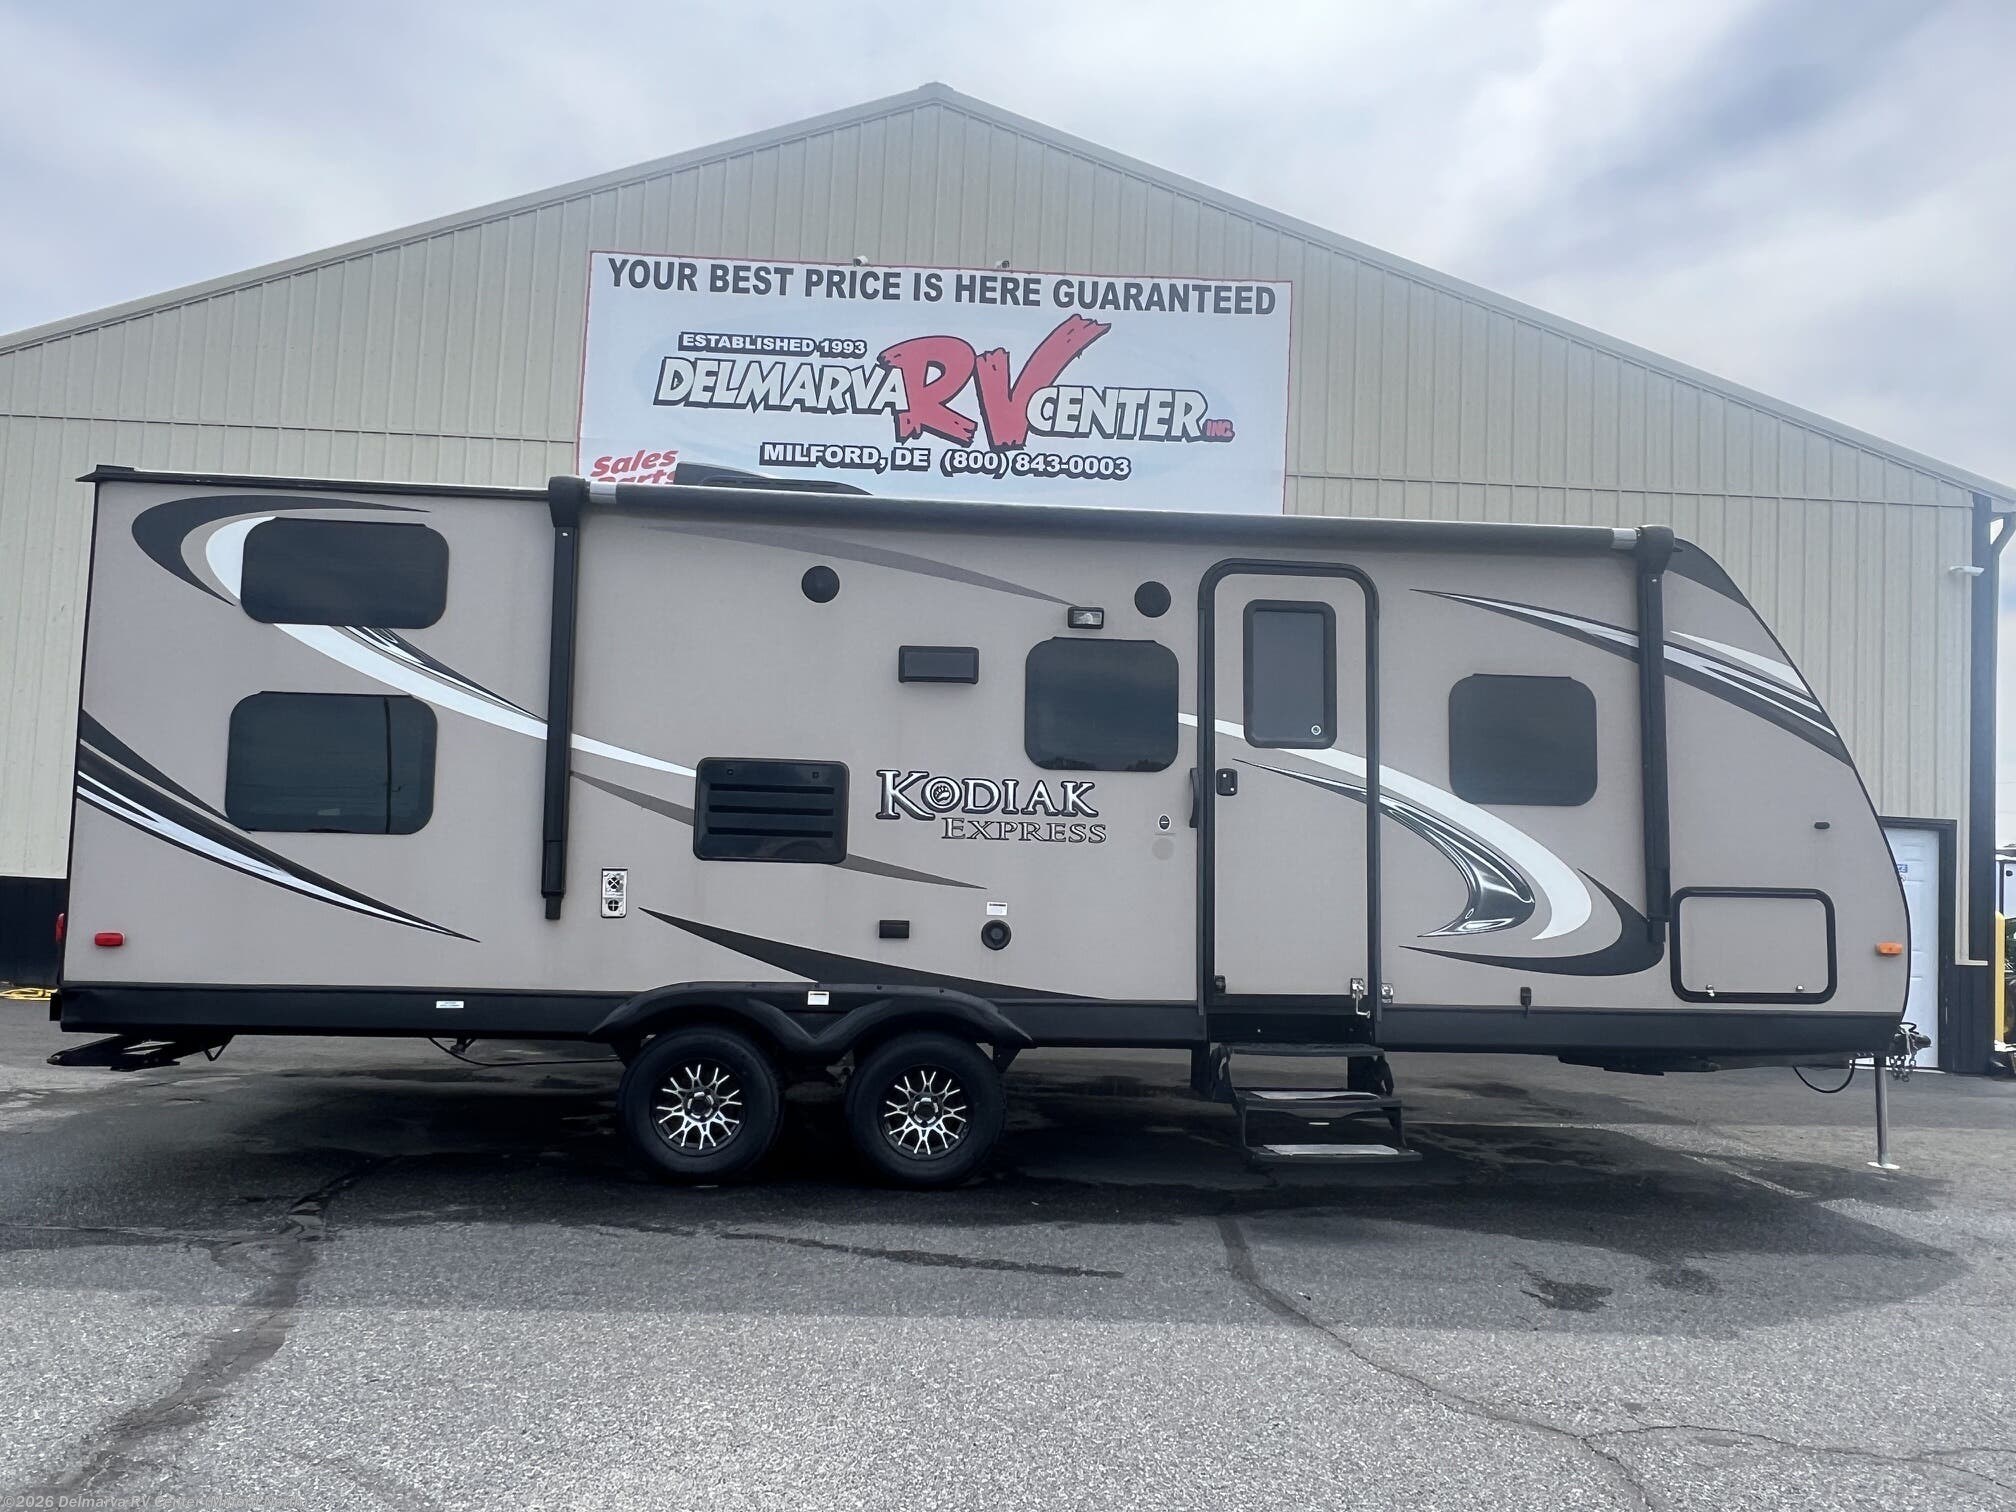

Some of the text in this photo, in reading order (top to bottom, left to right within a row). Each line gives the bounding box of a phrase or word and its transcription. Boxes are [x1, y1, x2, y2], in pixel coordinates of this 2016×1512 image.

[608, 258, 1276, 315] YOUR BEST PRICE IS HERE GUARANTEED
[680, 332, 867, 357] ESTABLISHED 1993
[653, 357, 909, 415] DELMARVA
[877, 313, 1112, 451] RV
[1026, 385, 1208, 442] CENTER
[762, 443, 1131, 478] MILFORD, DE (800) 843-0003
[875, 768, 1099, 821] KODIAK
[941, 817, 1107, 844] EXPRESS
